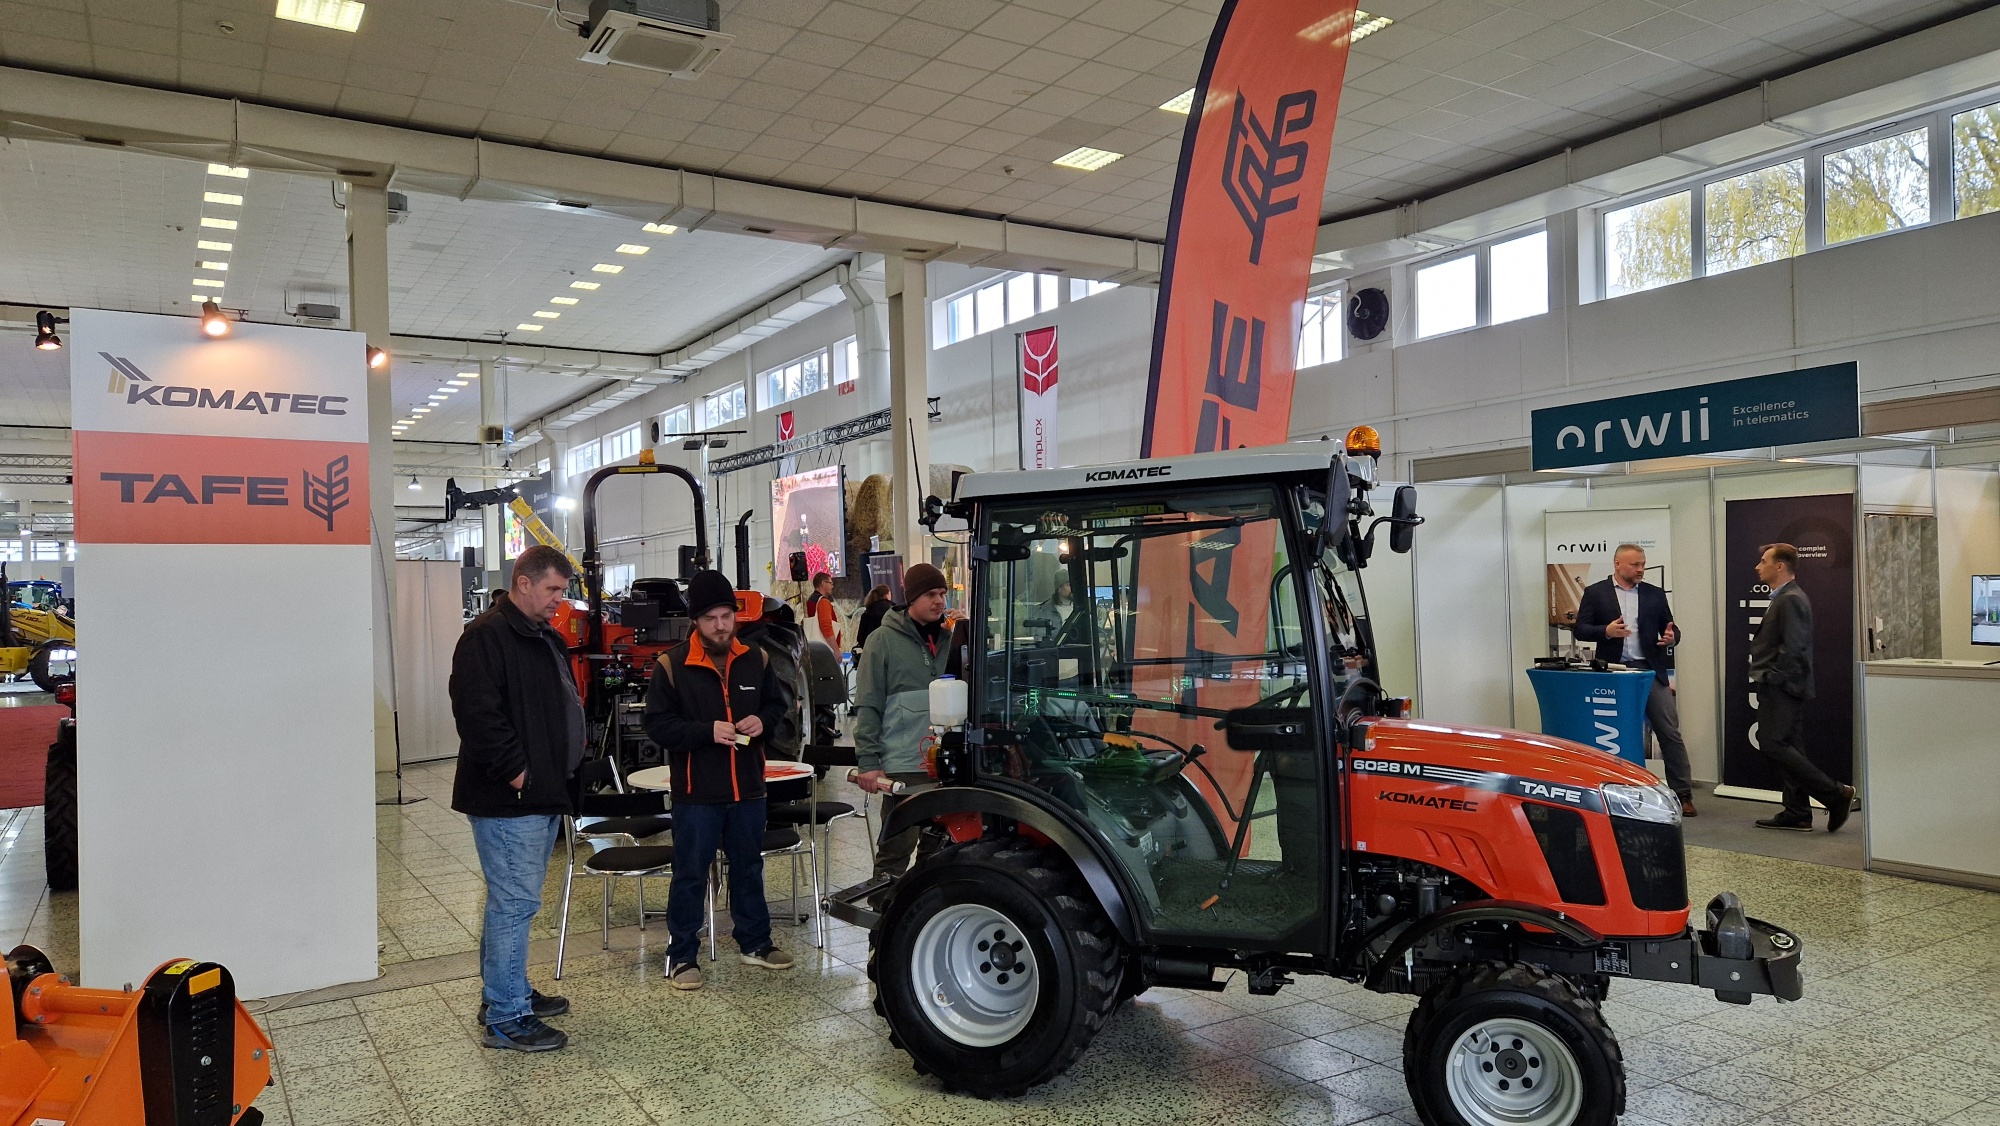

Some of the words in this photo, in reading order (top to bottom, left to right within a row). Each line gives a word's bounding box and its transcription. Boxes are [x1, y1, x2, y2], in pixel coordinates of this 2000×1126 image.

[127, 384, 349, 415] KOMATEC
[1732, 400, 1796, 416] Excellence
[1732, 417, 1744, 427] in
[1746, 409, 1810, 426] telematics
[1085, 466, 1172, 482] KOMATEC
[100, 472, 289, 506] TAFE
[1592, 688, 1616, 696] .COM
[1353, 759, 1401, 774] 6028
[1403, 763, 1421, 776] M
[1378, 790, 1480, 812] KOMATEC
[1519, 780, 1583, 804] TAFE
